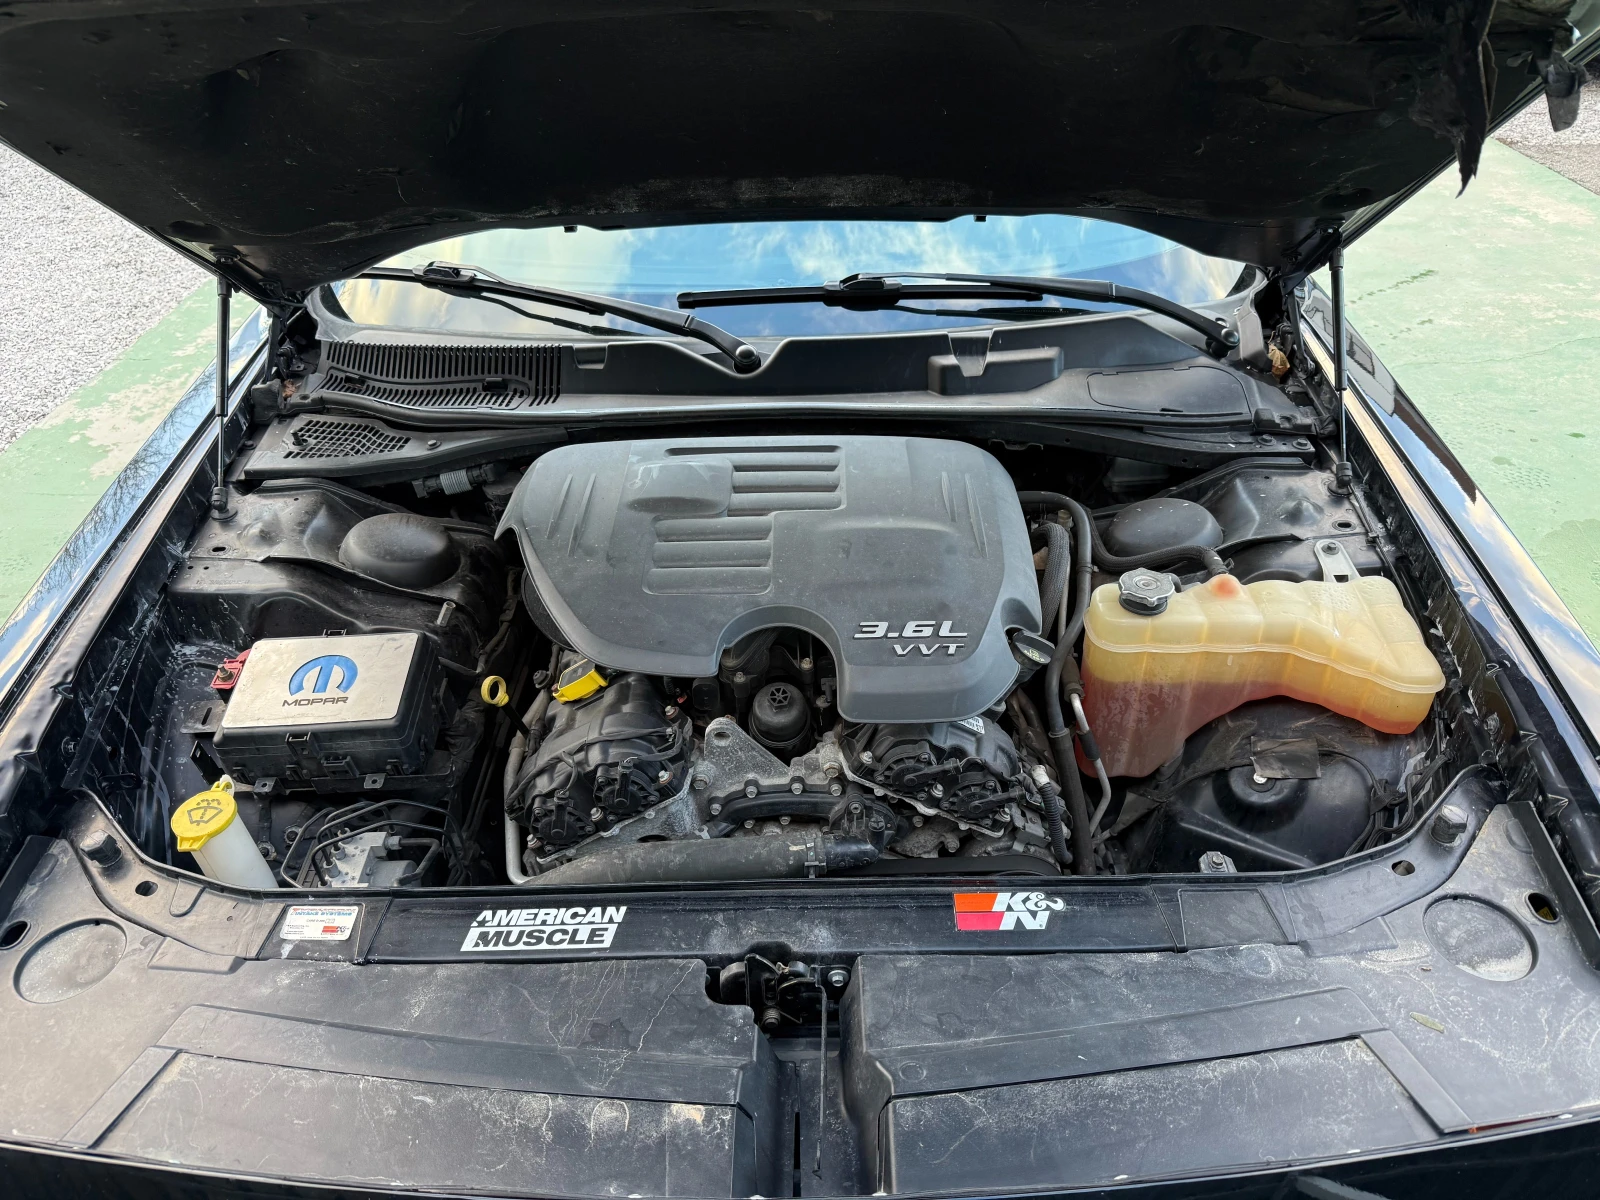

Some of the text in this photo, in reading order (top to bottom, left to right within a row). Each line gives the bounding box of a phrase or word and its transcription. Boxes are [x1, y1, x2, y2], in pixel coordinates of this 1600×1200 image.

[853, 620, 968, 638] 3.6L
[893, 643, 965, 657] VVT
[282, 697, 349, 707] MOPAR
[470, 906, 628, 927] AMERICAN
[472, 927, 609, 949] MUSCLE
